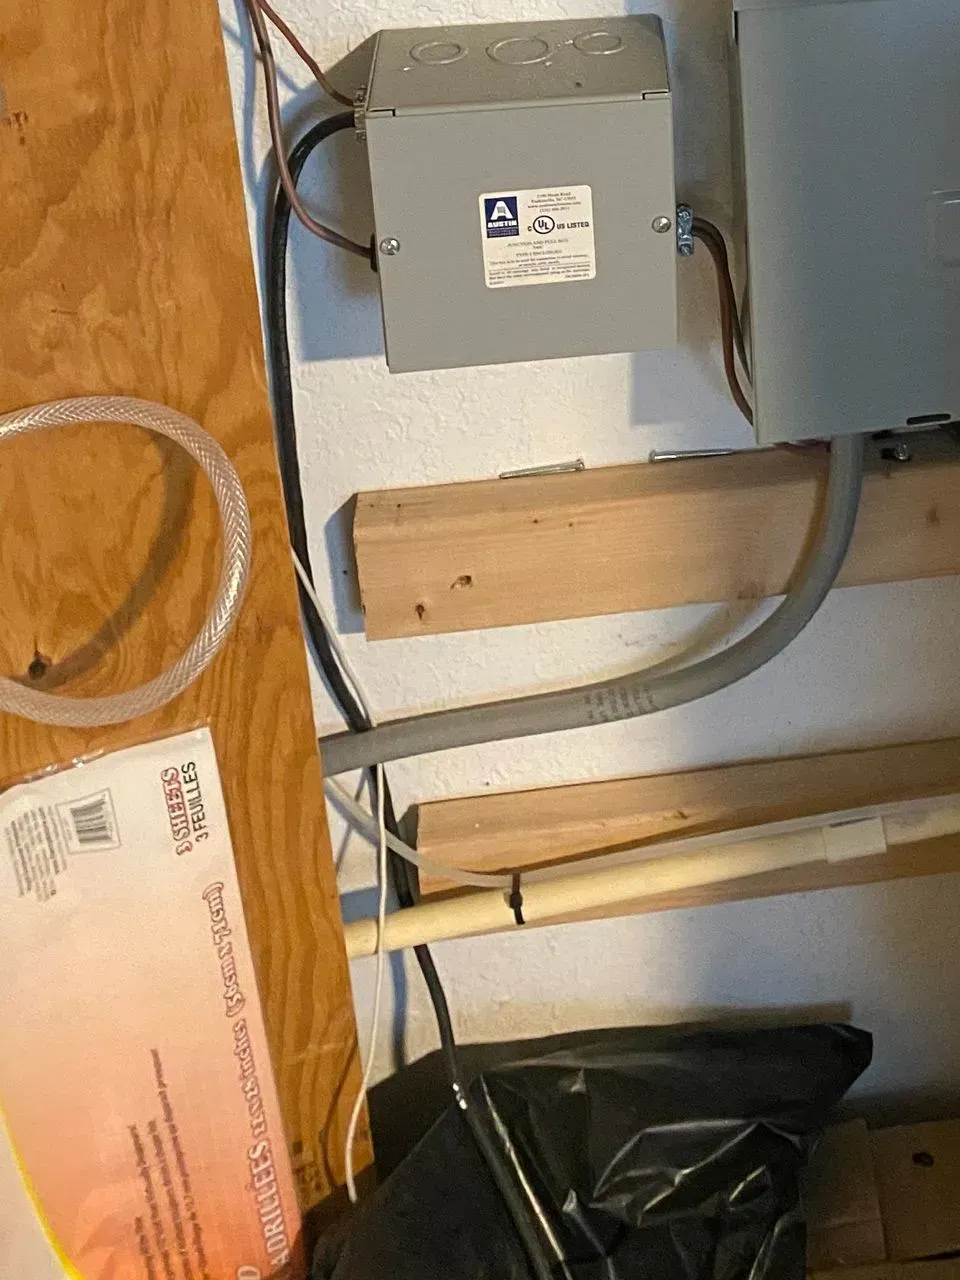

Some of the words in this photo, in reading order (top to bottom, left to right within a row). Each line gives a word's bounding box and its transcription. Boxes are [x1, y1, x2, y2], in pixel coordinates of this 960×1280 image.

[567, 221, 590, 229] LISTED
[160, 766, 191, 842] SHEETS
[181, 761, 208, 832] FEUILLES
[175, 840, 193, 856] 3
[195, 831, 209, 843] 3
[202, 881, 231, 945] 71cm)
[221, 956, 246, 1018] (56cm
[233, 1018, 256, 1078] inches
